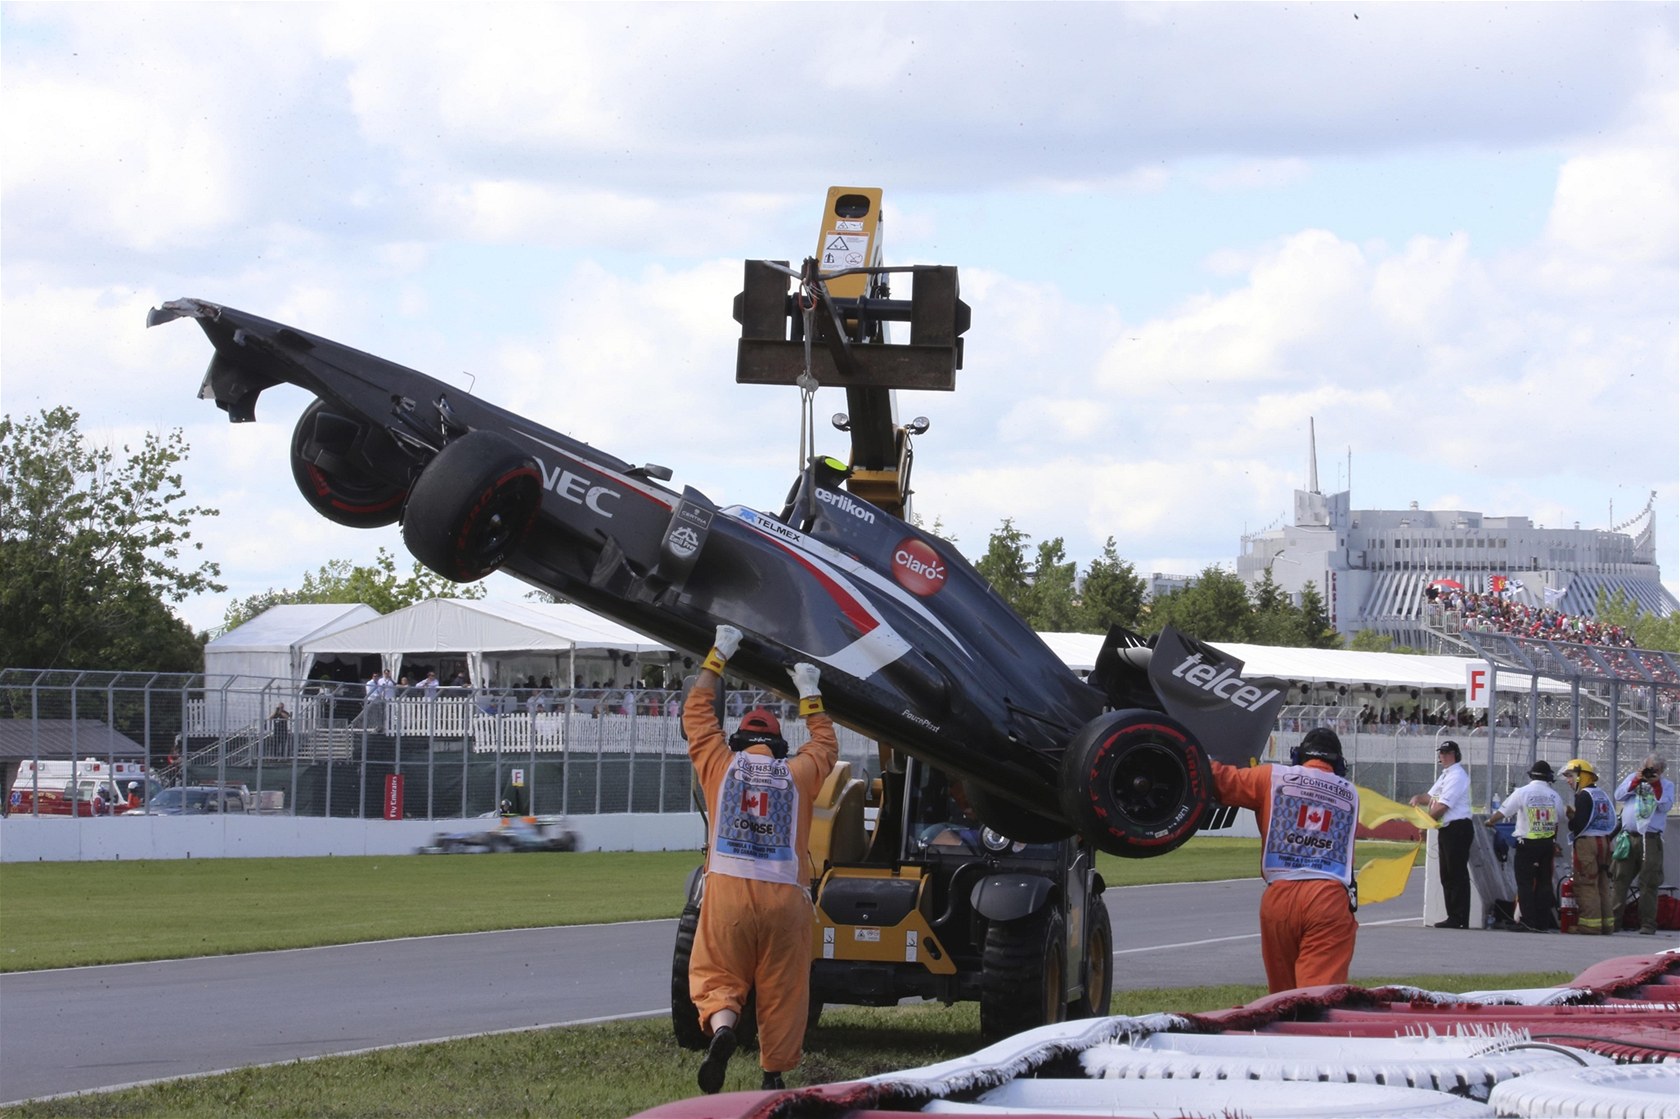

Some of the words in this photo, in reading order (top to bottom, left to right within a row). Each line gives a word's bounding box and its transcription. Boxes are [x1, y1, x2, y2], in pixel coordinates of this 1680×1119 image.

[532, 455, 621, 518] NEC
[756, 517, 801, 543] TELMEX
[895, 550, 938, 580] Claro
[1172, 652, 1280, 712] telcel
[1471, 671, 1485, 701] F
[514, 771, 522, 783] F
[734, 818, 773, 835] COURSE
[1287, 833, 1332, 849] COURSE
